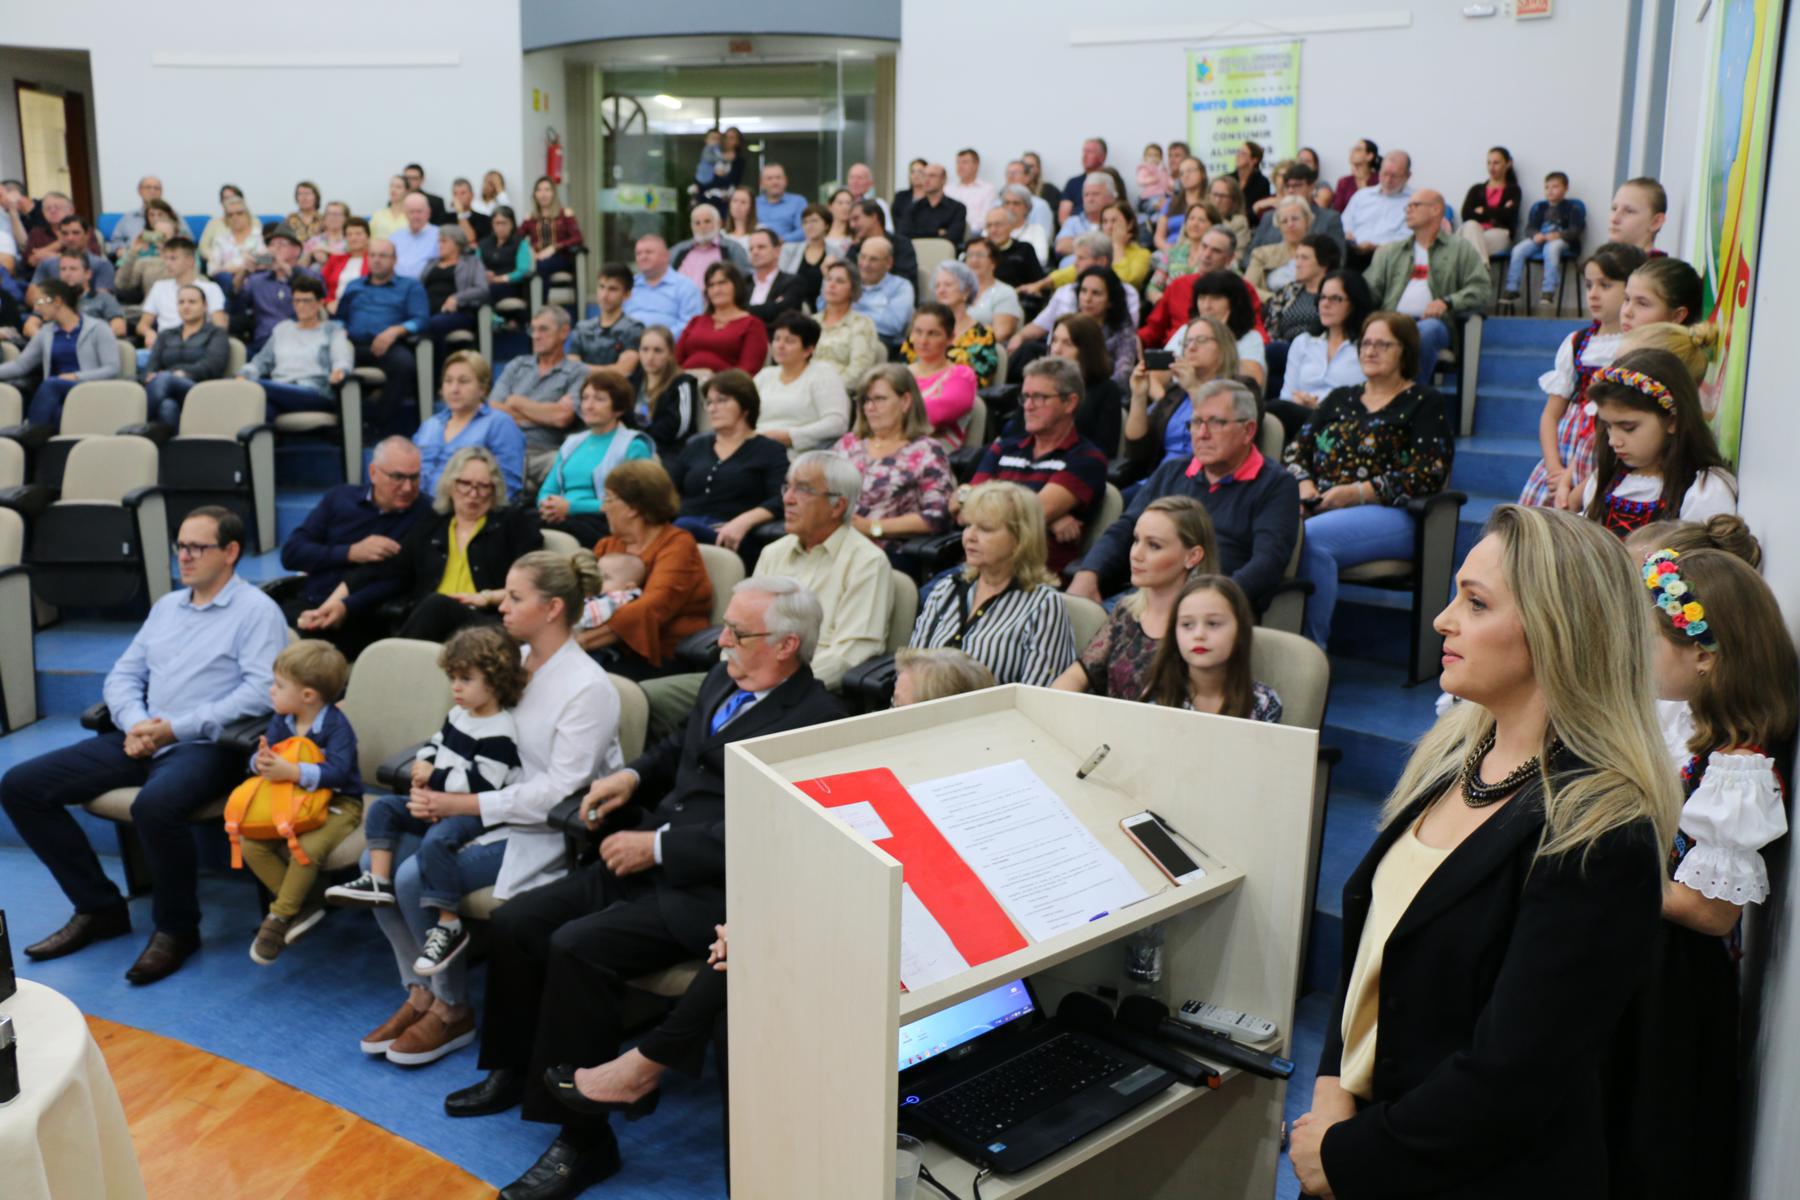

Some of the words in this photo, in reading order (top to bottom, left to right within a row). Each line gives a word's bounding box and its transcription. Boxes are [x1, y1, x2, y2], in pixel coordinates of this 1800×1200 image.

[1192, 99, 1227, 111] MUITO
[1216, 116, 1238, 125] POR
[1244, 114, 1267, 124] NÃO
[1212, 130, 1271, 141] CONSUMIR
